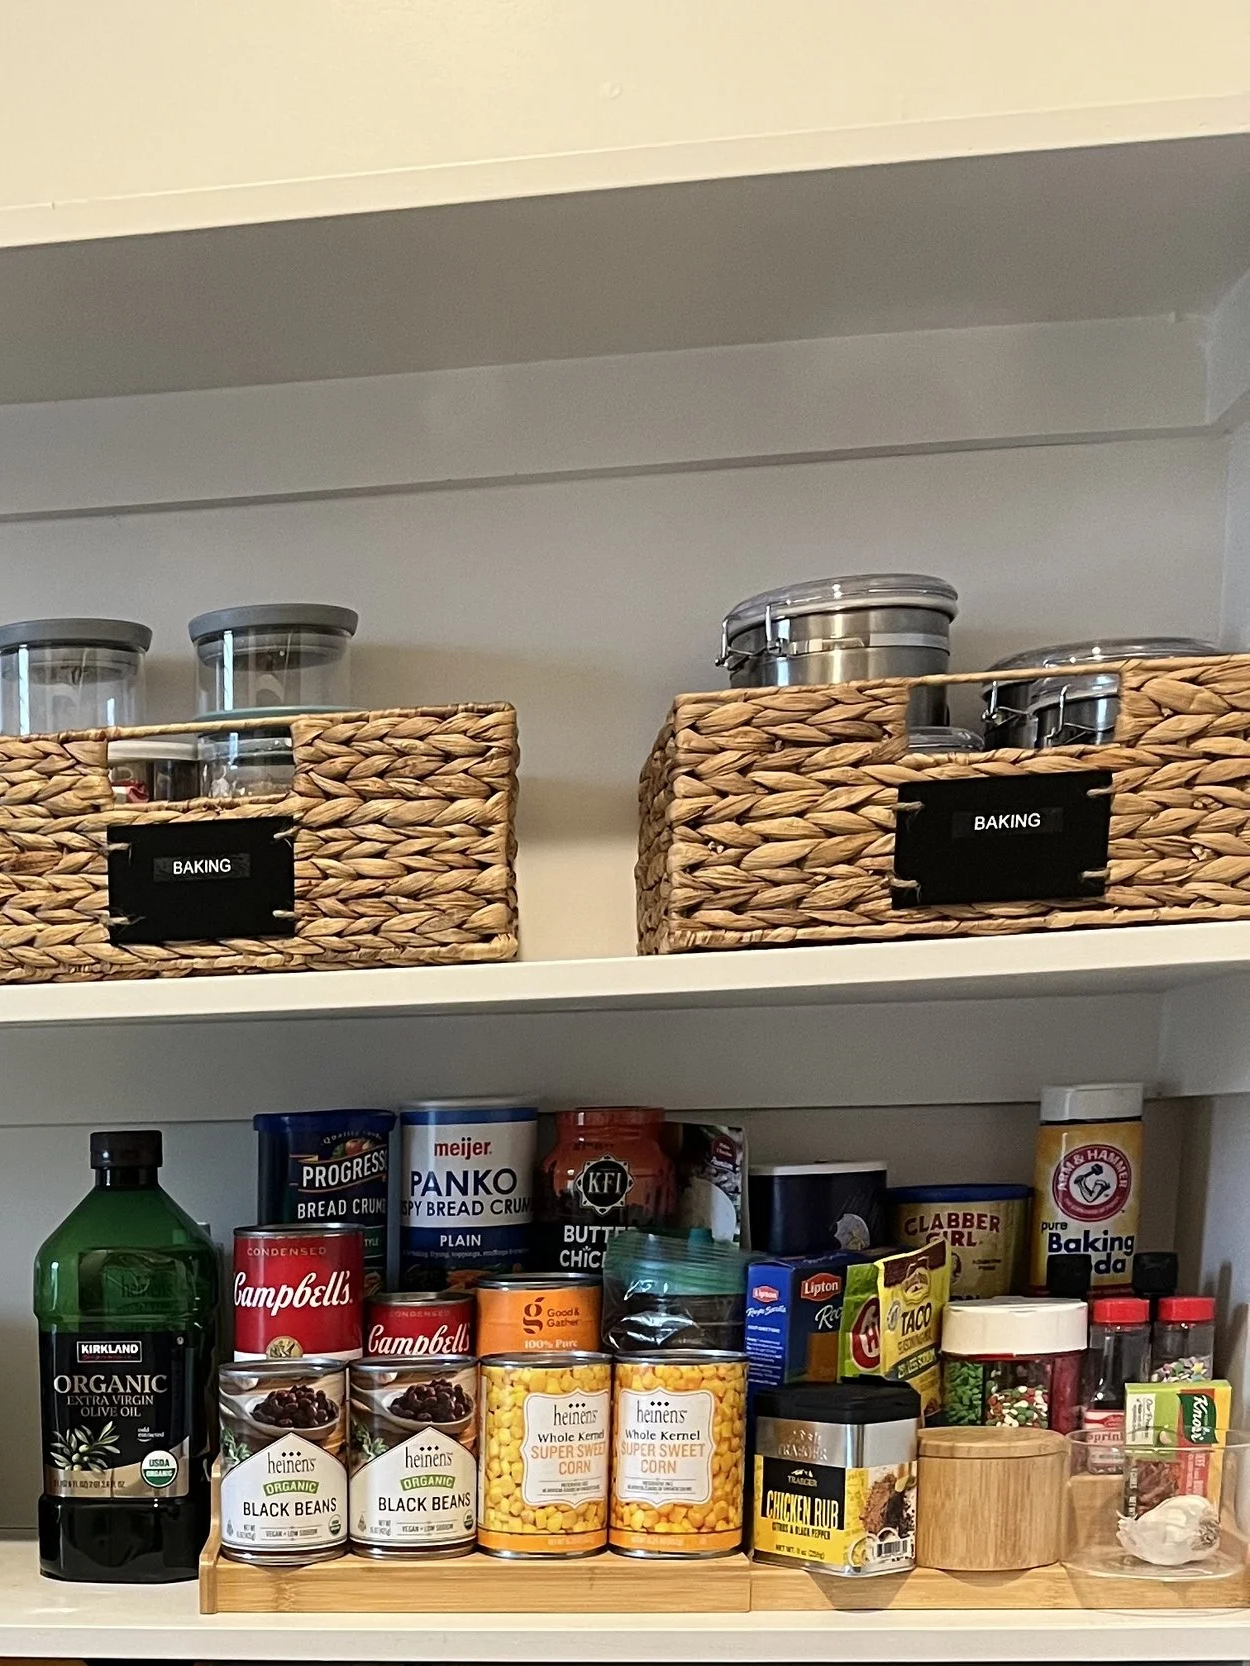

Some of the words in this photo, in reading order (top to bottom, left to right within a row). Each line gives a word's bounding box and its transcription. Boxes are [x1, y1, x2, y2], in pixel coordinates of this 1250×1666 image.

[973, 813, 1042, 832] BAKING
[173, 858, 232, 875] BAKING
[434, 1138, 492, 1160] meijer
[1058, 1160, 1074, 1192] ARM
[1073, 1154, 1085, 1166] &
[1088, 1149, 1129, 1189] HAMMER
[410, 1168, 518, 1197] PANKO
[588, 1173, 622, 1194] KFI
[298, 1199, 347, 1219] BREAD
[427, 1201, 484, 1217] BREAD
[904, 1212, 1000, 1236] CLABBER
[1041, 1221, 1068, 1234] pure
[440, 1234, 482, 1248] PLAIN
[1048, 1229, 1135, 1258] Baking
[246, 1247, 327, 1258] CONDENSED
[234, 1271, 354, 1317] Campbell's
[804, 1282, 839, 1297] Lipton
[547, 1318, 580, 1328] Gather
[901, 1302, 932, 1337] TACO
[82, 1344, 139, 1354] KIRKLAND
[53, 1374, 168, 1394] ORGANIC
[67, 1395, 110, 1405] EXTRA
[113, 1395, 154, 1405] VIRGIN
[81, 1407, 118, 1417] OLIVE
[120, 1407, 142, 1417] OIL
[538, 1430, 575, 1443] Whole
[625, 1429, 656, 1441] Whole
[660, 1430, 701, 1442] Kernel
[531, 1444, 575, 1459] SUPER
[577, 1442, 606, 1457] SWEET
[621, 1442, 655, 1457] SUPER
[661, 1443, 706, 1458] SWEET
[149, 1458, 170, 1468] USDA
[559, 1460, 591, 1475] CORN
[640, 1460, 677, 1474] CORN
[265, 1482, 317, 1495] ORGANIC
[403, 1476, 453, 1490] ORGANIC
[243, 1501, 290, 1517] BLACK
[295, 1497, 337, 1516] BEANS
[378, 1496, 426, 1512] BLACK
[432, 1492, 471, 1510] BEANS
[766, 1490, 811, 1526] CHICKEN
[814, 1497, 839, 1530] RUB
